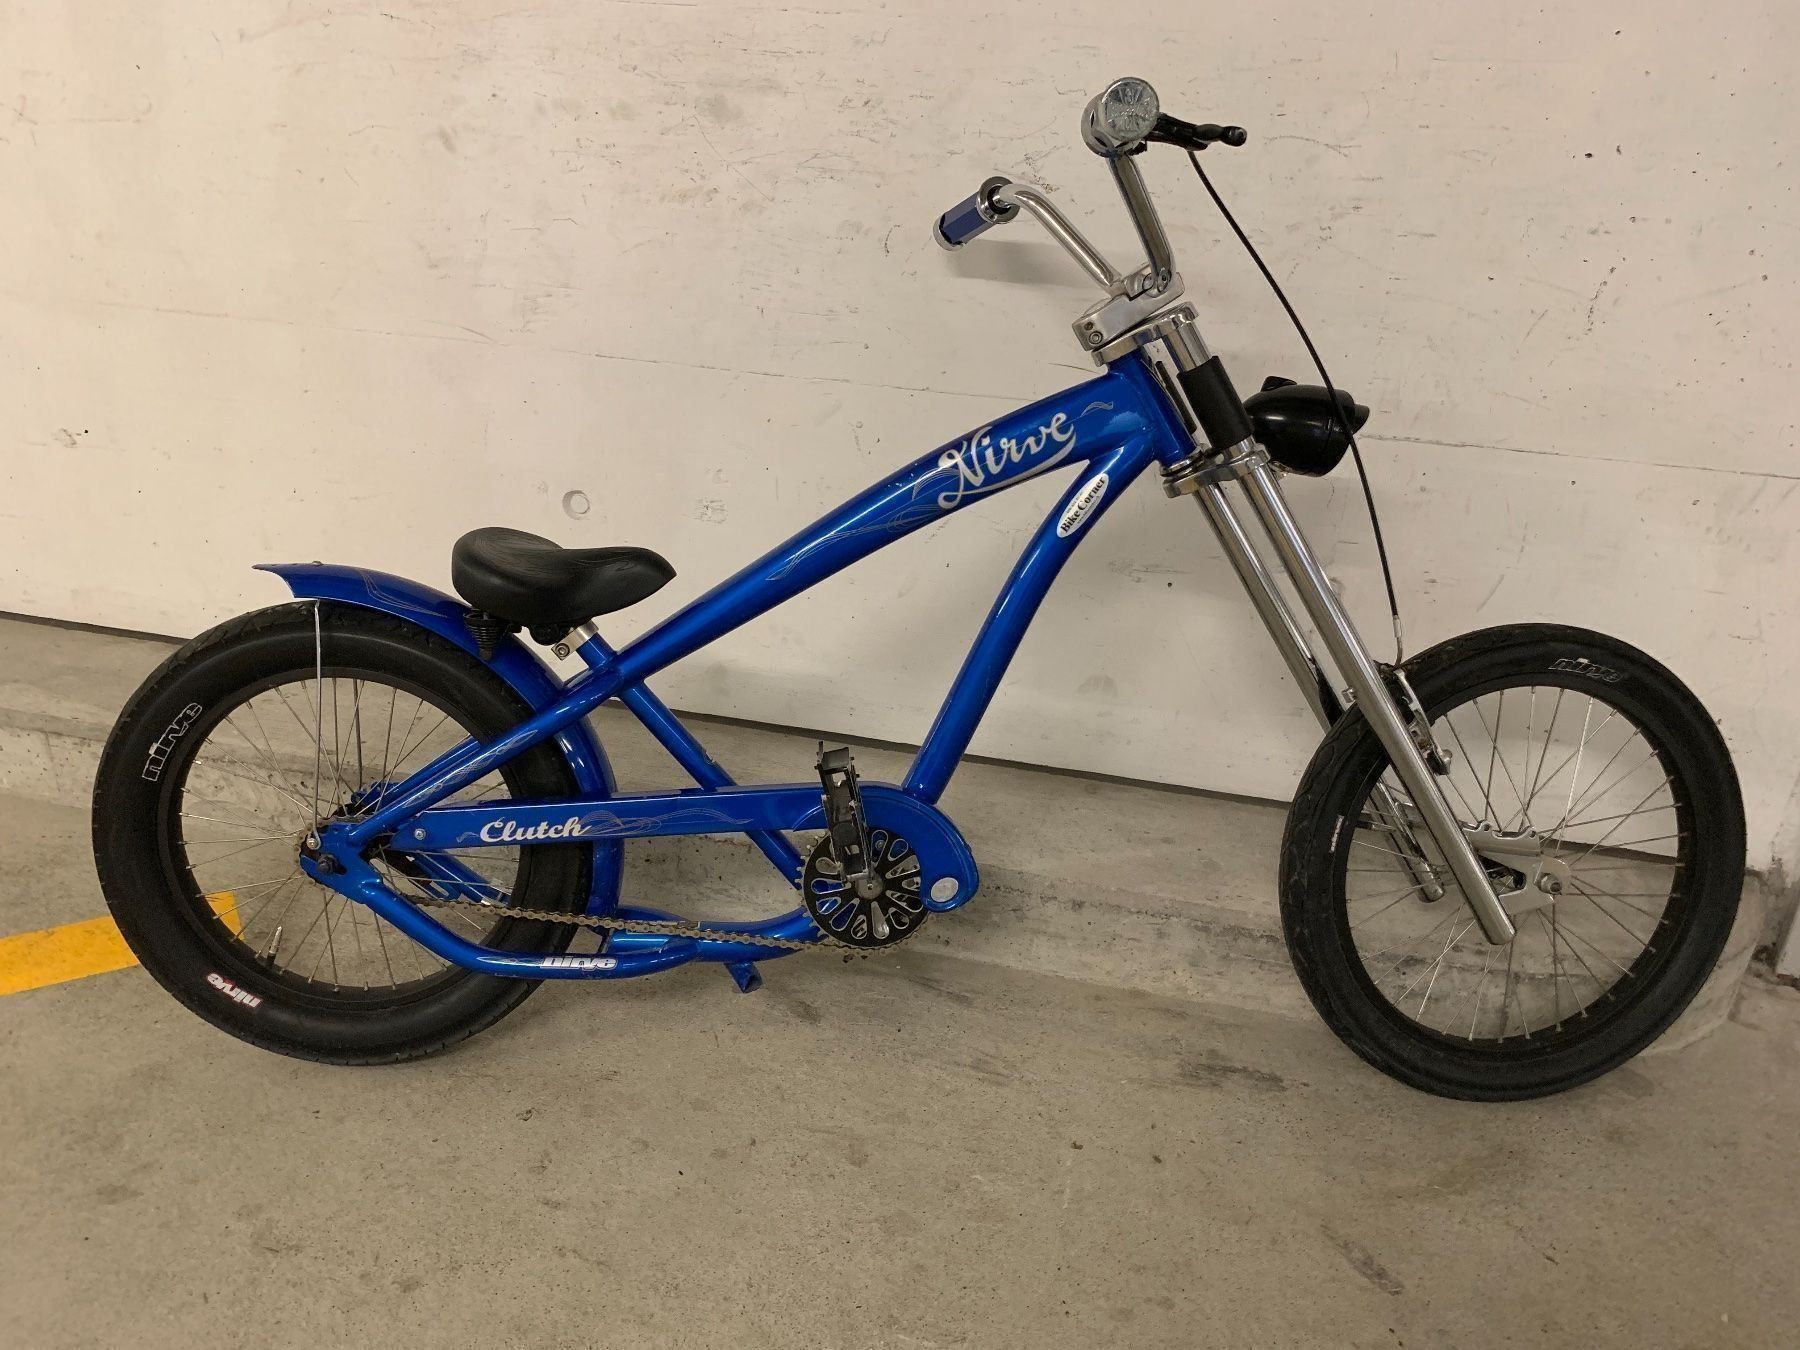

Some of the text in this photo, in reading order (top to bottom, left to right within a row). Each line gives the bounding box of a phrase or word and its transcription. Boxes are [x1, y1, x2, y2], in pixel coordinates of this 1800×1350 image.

[938, 412, 1077, 510] Nirve
[1060, 510, 1081, 533] Bike
[1077, 476, 1105, 511] Corner
[142, 702, 203, 782] nirve
[479, 816, 592, 843] Clutch
[540, 955, 618, 972] nirve
